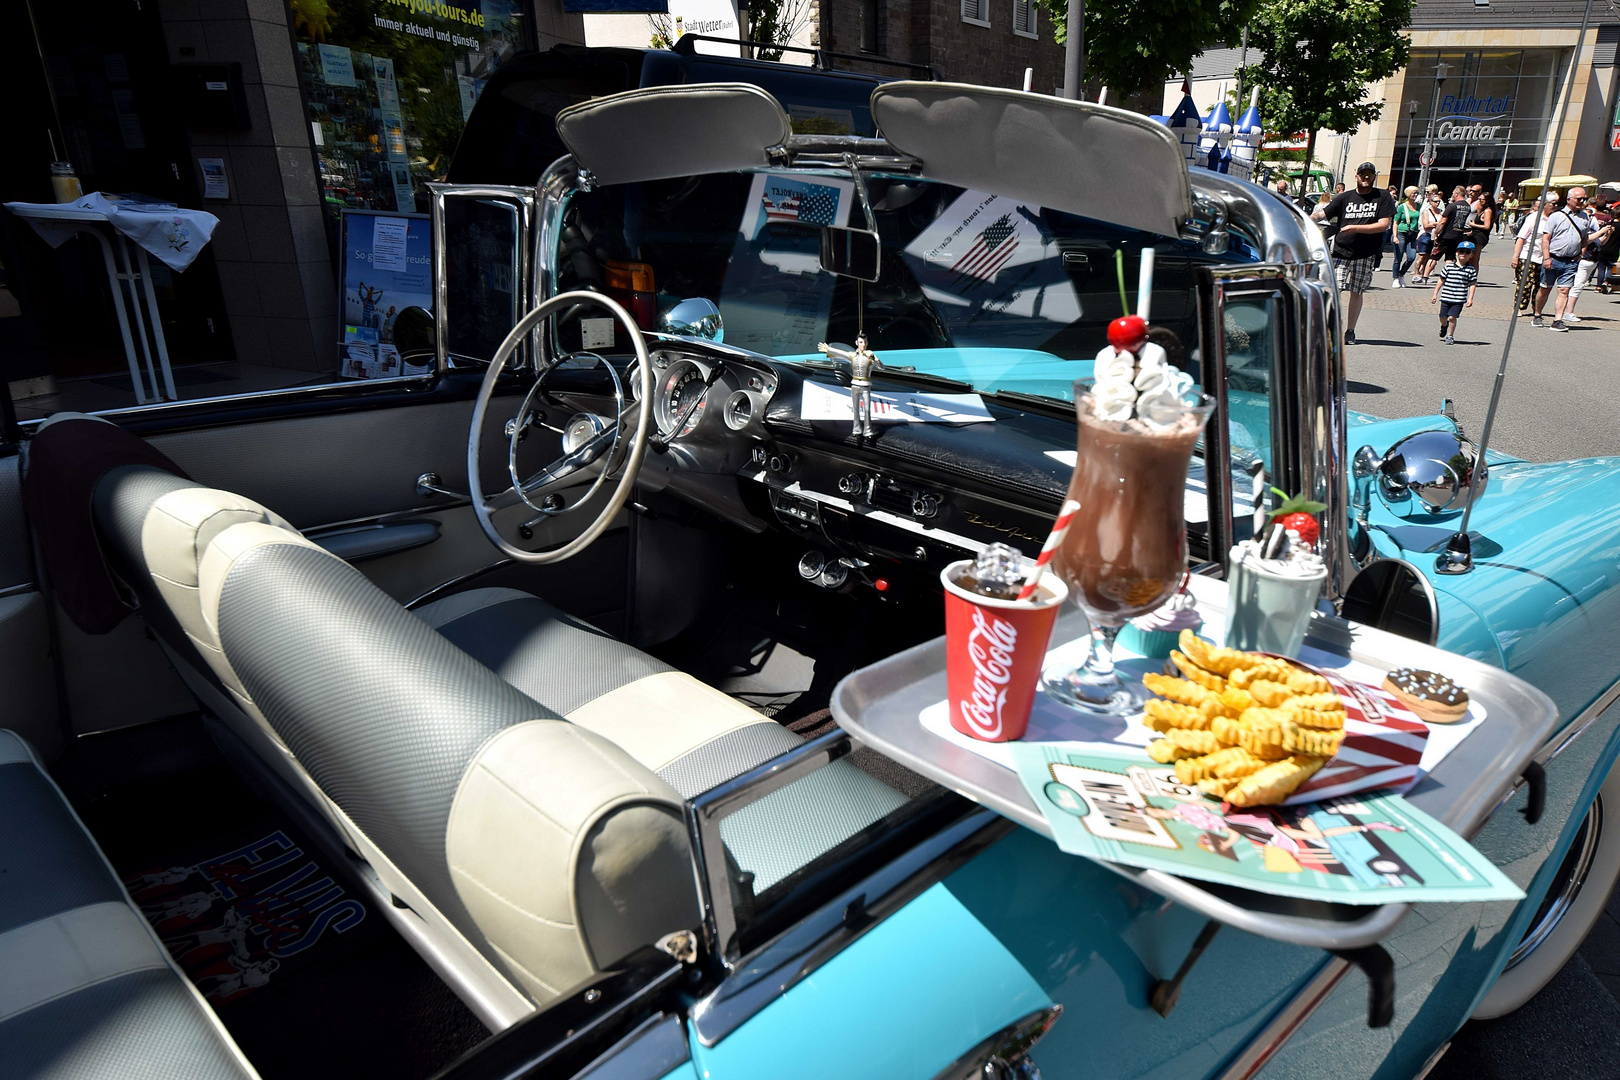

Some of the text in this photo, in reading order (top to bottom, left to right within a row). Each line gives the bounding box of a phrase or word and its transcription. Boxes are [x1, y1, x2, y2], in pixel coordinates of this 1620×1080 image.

[374, 13, 479, 51] immer aktuell und günstig
[684, 20, 698, 32] Stadt
[698, 20, 722, 33] Wetter
[1440, 95, 1510, 113] Ruhrtal
[1437, 121, 1500, 141] Center
[1345, 202, 1377, 213] ÖLICH
[355, 250, 366, 259] So
[405, 253, 431, 265] reude
[960, 605, 1018, 740] Coca-Cola
[197, 829, 367, 958] ELVIS
